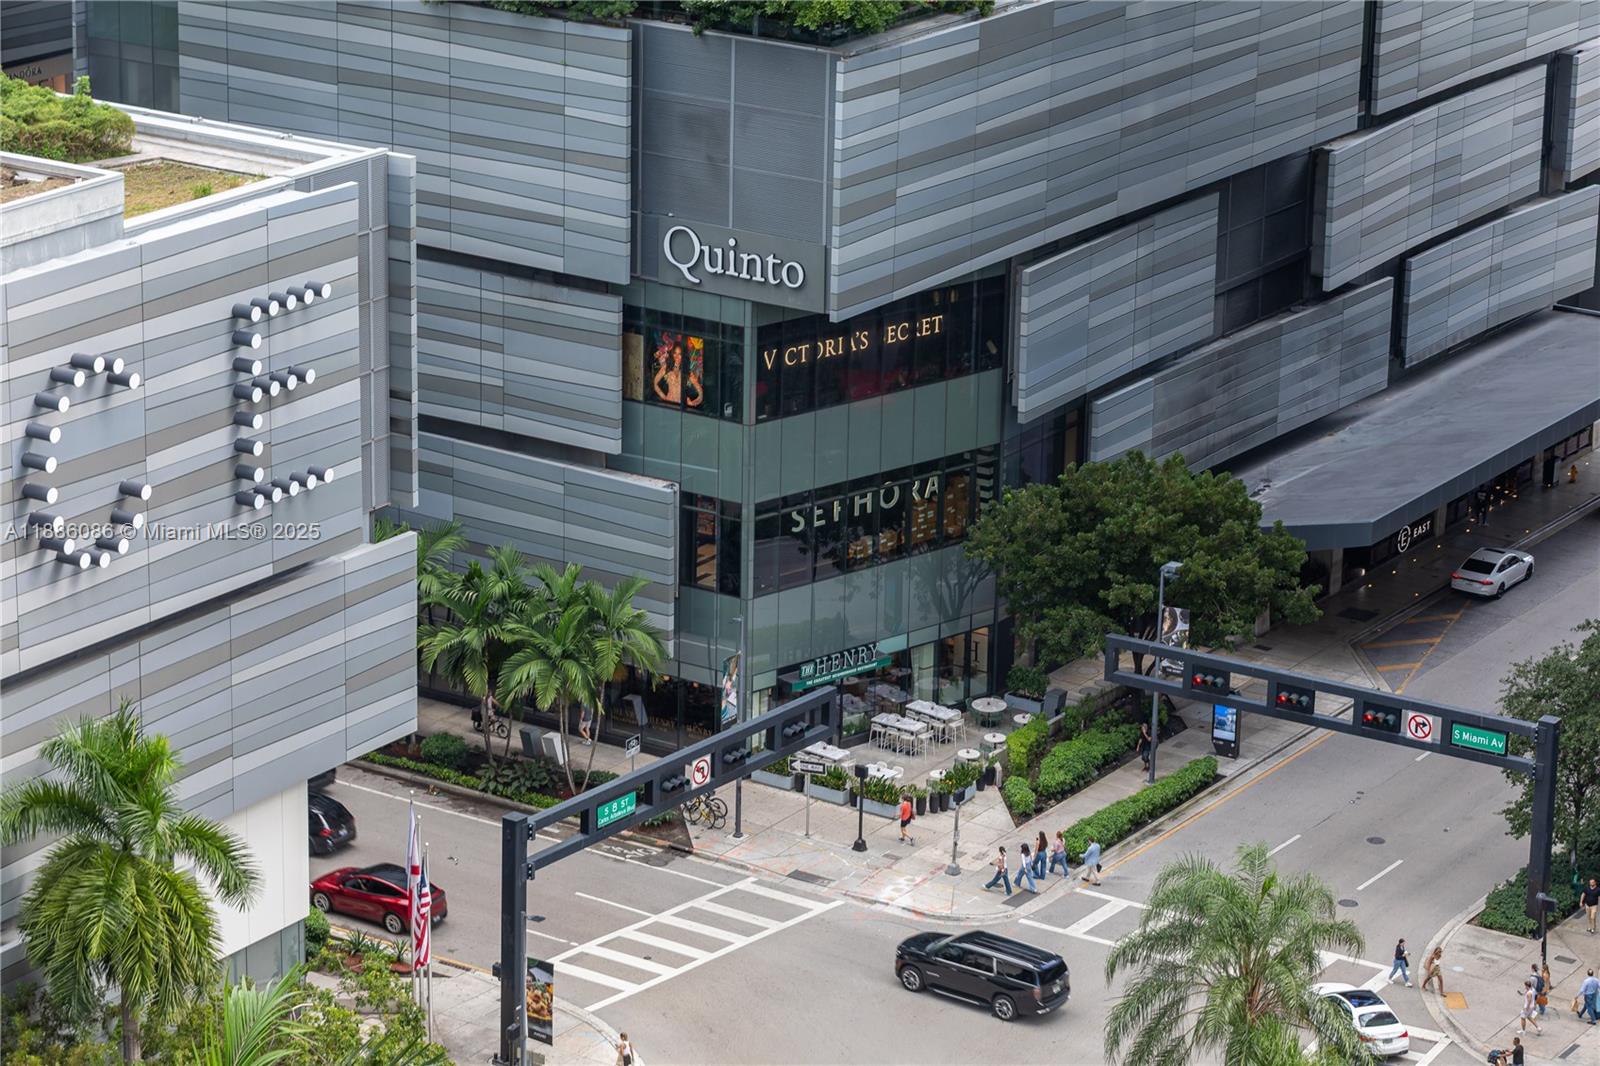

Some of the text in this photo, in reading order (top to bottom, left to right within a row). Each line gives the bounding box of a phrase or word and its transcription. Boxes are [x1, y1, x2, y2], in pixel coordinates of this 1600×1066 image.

[5, 66, 42, 80] ANDORA
[663, 225, 806, 289] Quinto
[764, 314, 943, 371] VCTRI'S ECET
[1413, 520, 1431, 538] EAST
[801, 663, 815, 677] THE
[815, 641, 880, 677] HENRY
[1454, 729, 1504, 749] S Miami Av
[604, 797, 629, 816] S 8 ST
